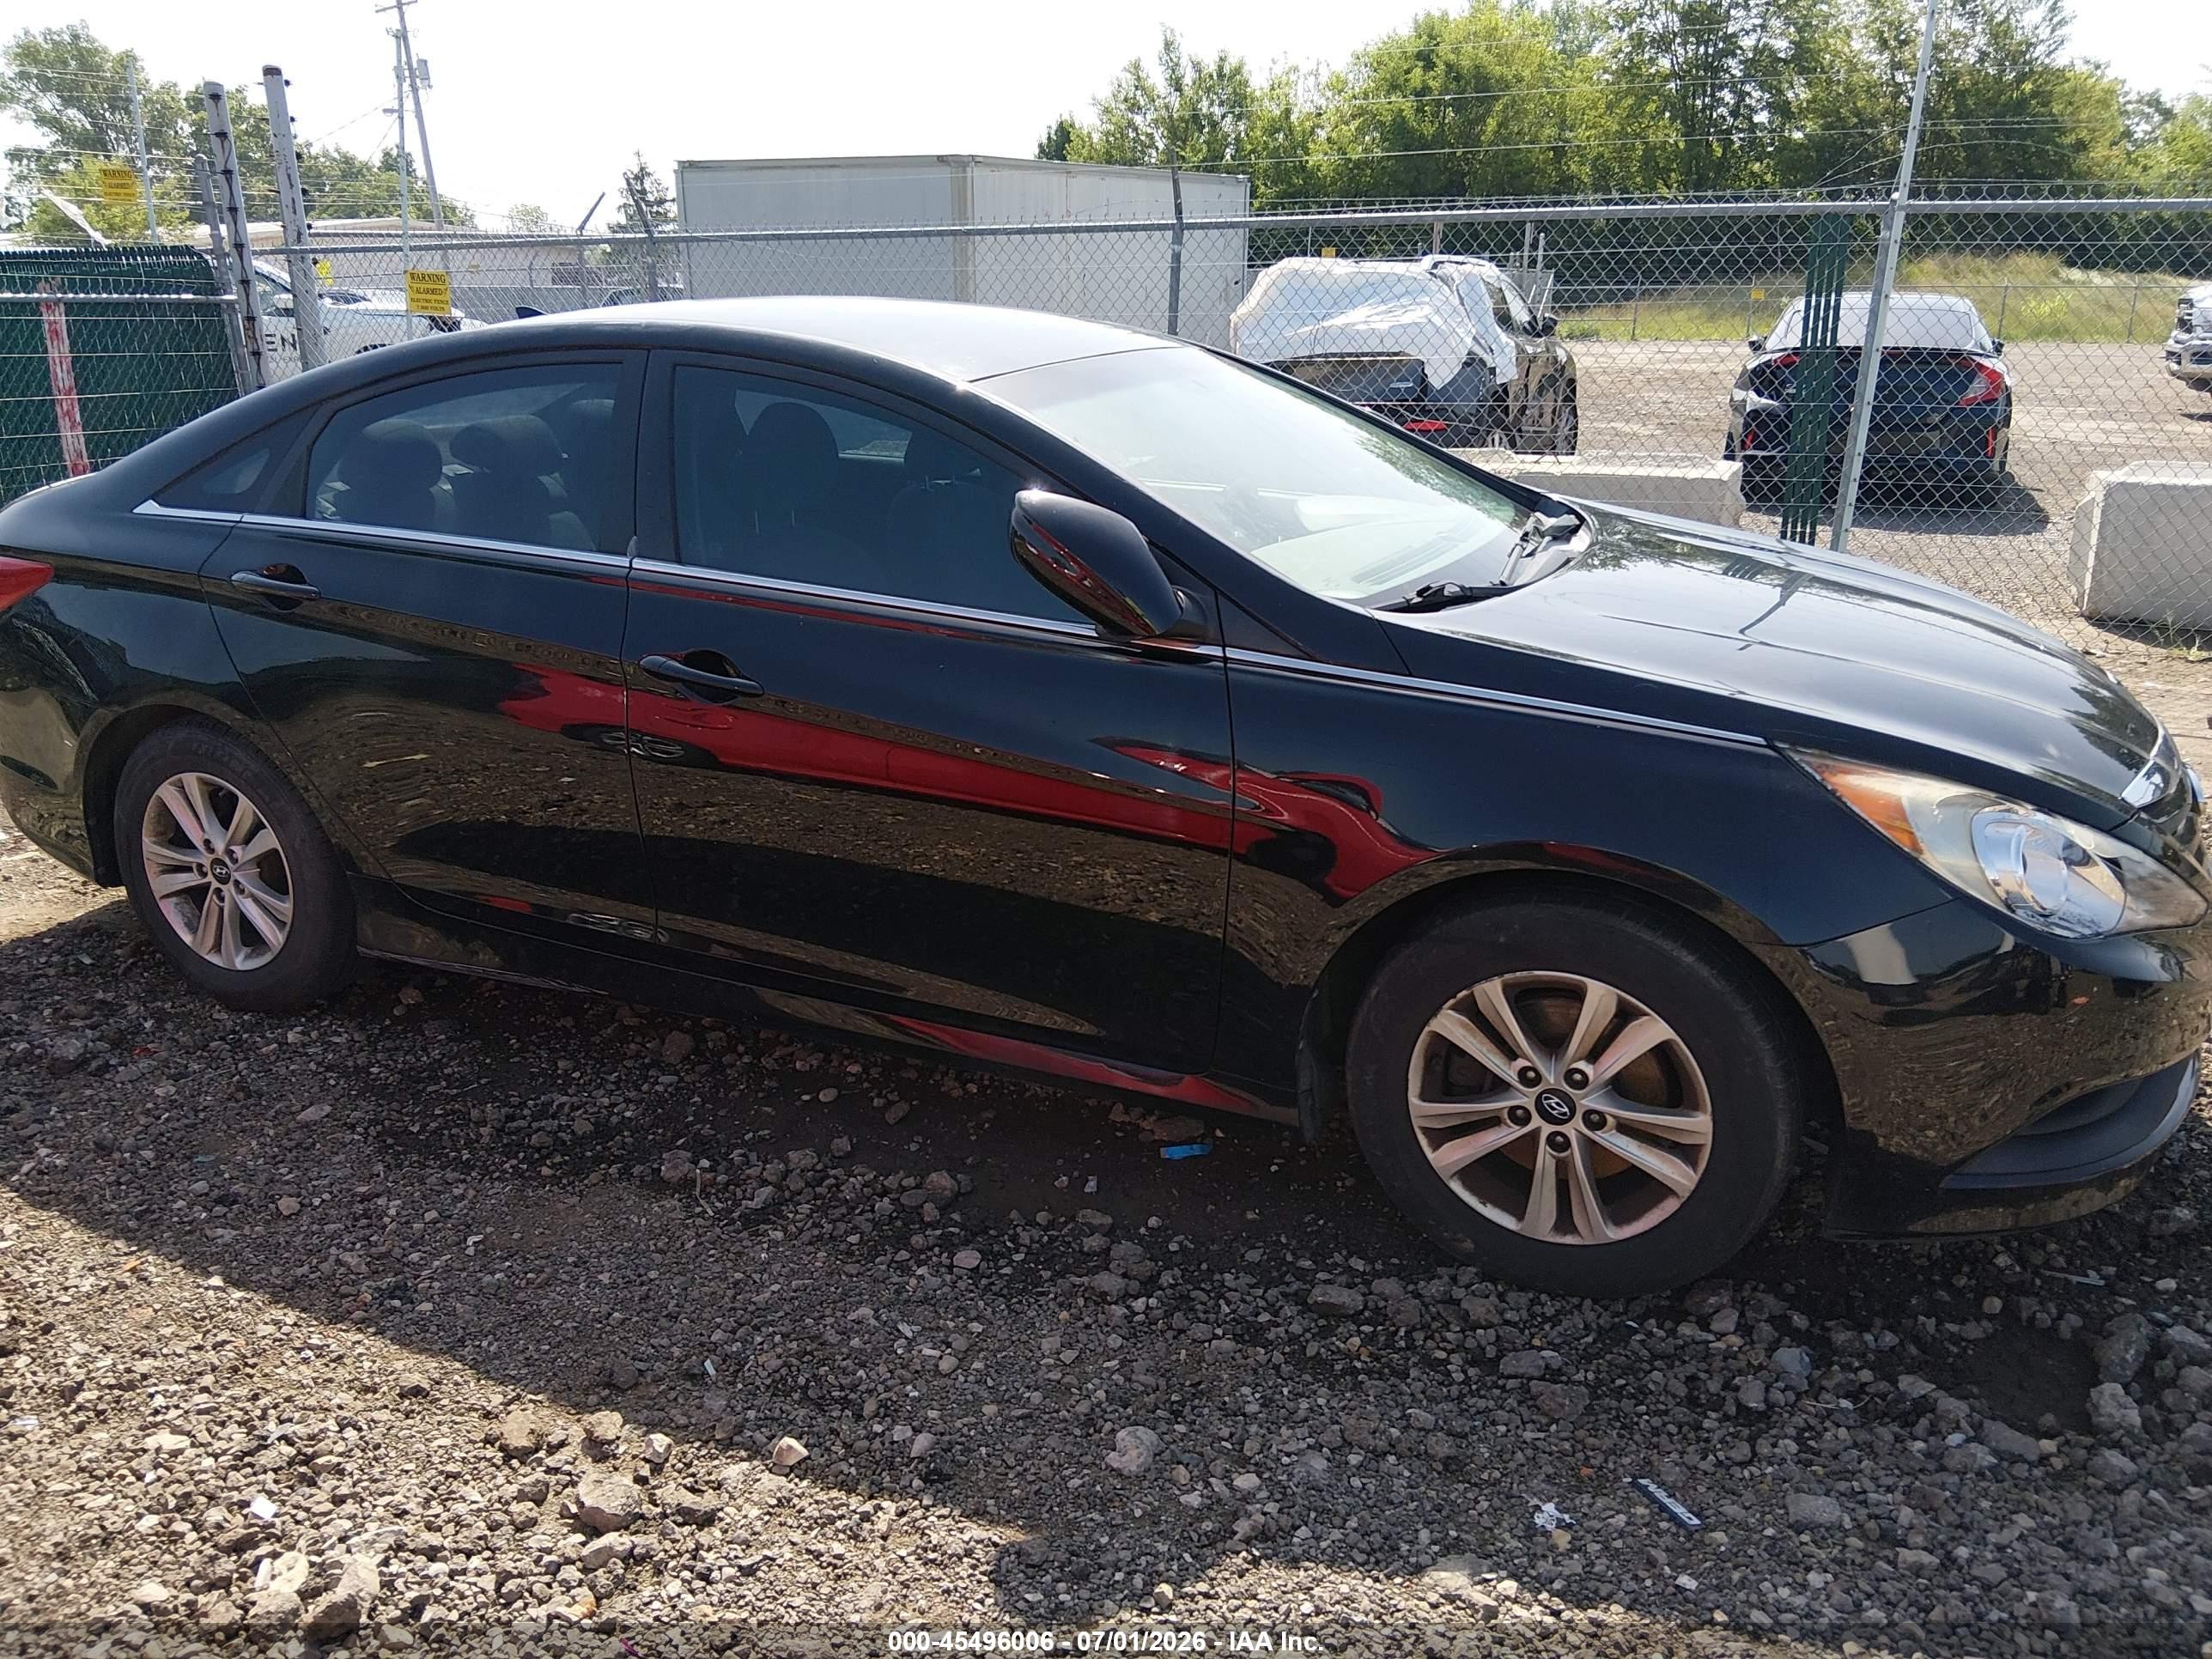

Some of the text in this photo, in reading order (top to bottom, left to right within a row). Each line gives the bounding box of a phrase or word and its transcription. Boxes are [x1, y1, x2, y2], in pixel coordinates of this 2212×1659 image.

[102, 169, 132, 179] WARNING
[410, 272, 447, 283] WARNING
[416, 287, 444, 296] ALARMED
